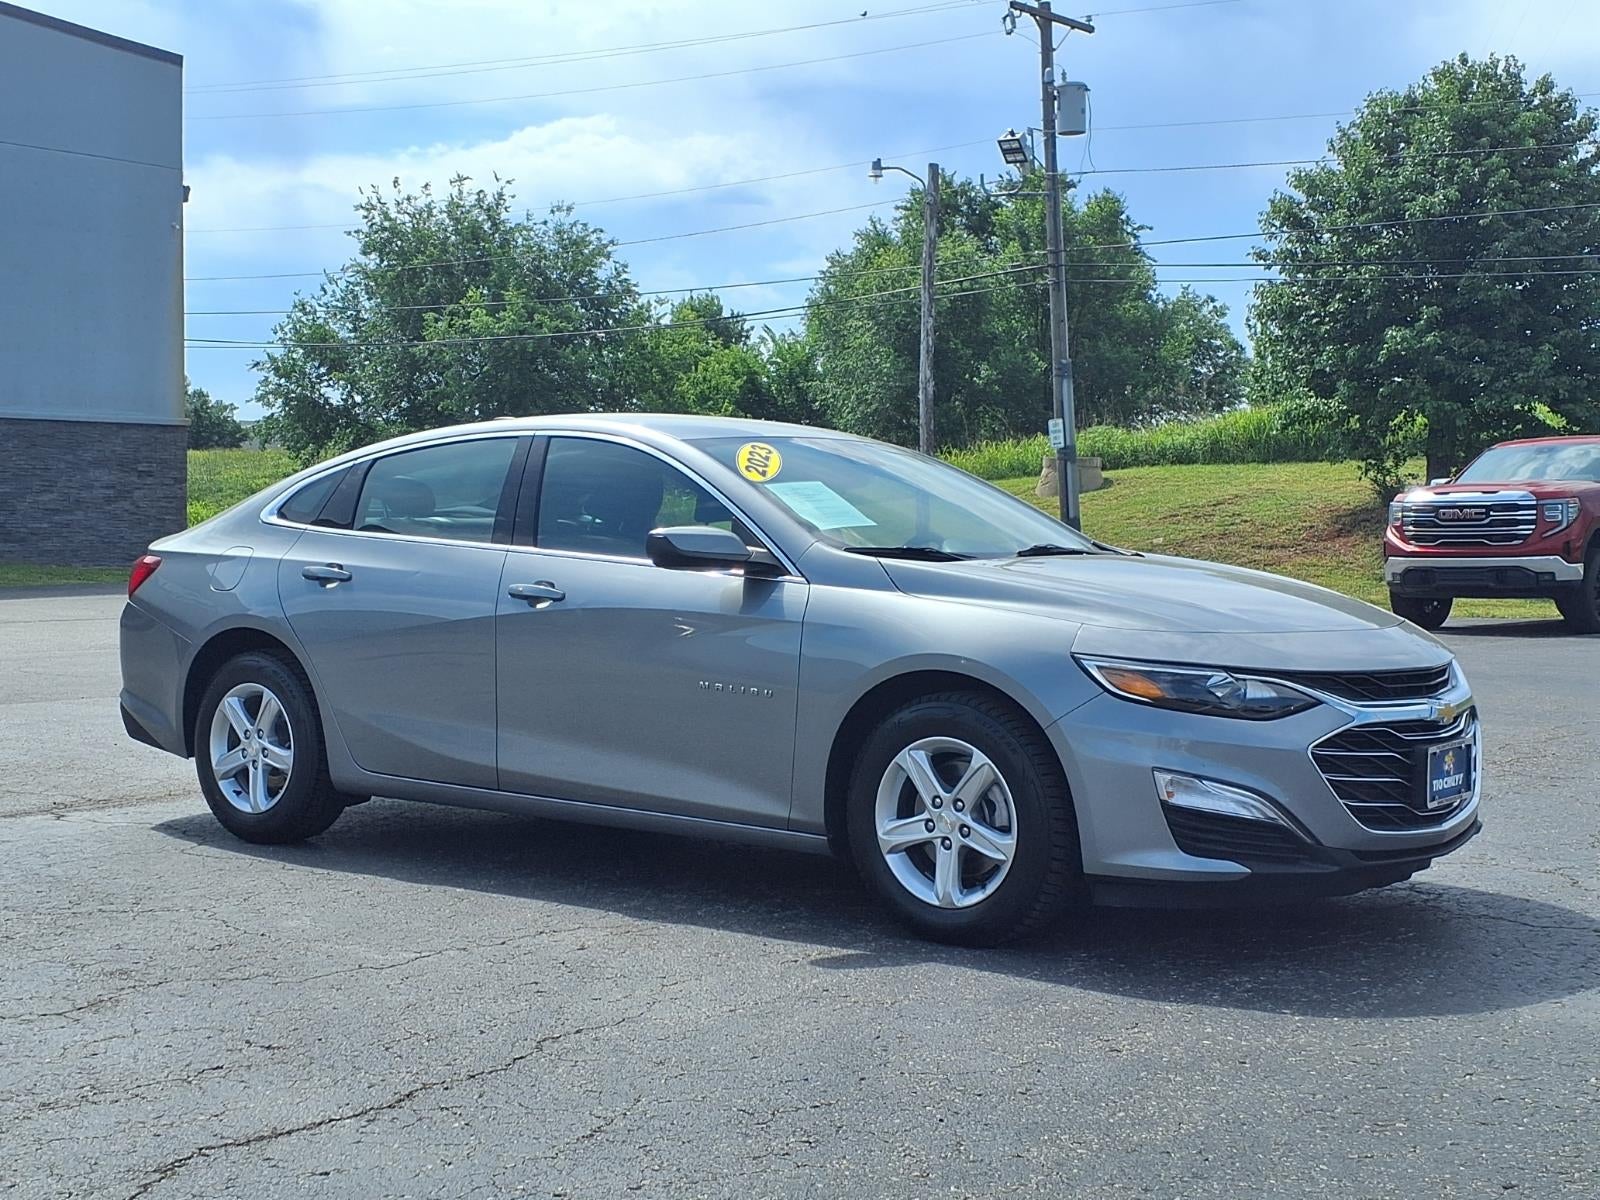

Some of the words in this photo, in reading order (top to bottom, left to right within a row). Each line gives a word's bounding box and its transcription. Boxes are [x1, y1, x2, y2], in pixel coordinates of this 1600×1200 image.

[744, 444, 773, 478] 2023
[1438, 508, 1486, 519] GMC
[698, 680, 774, 698] MALIBU
